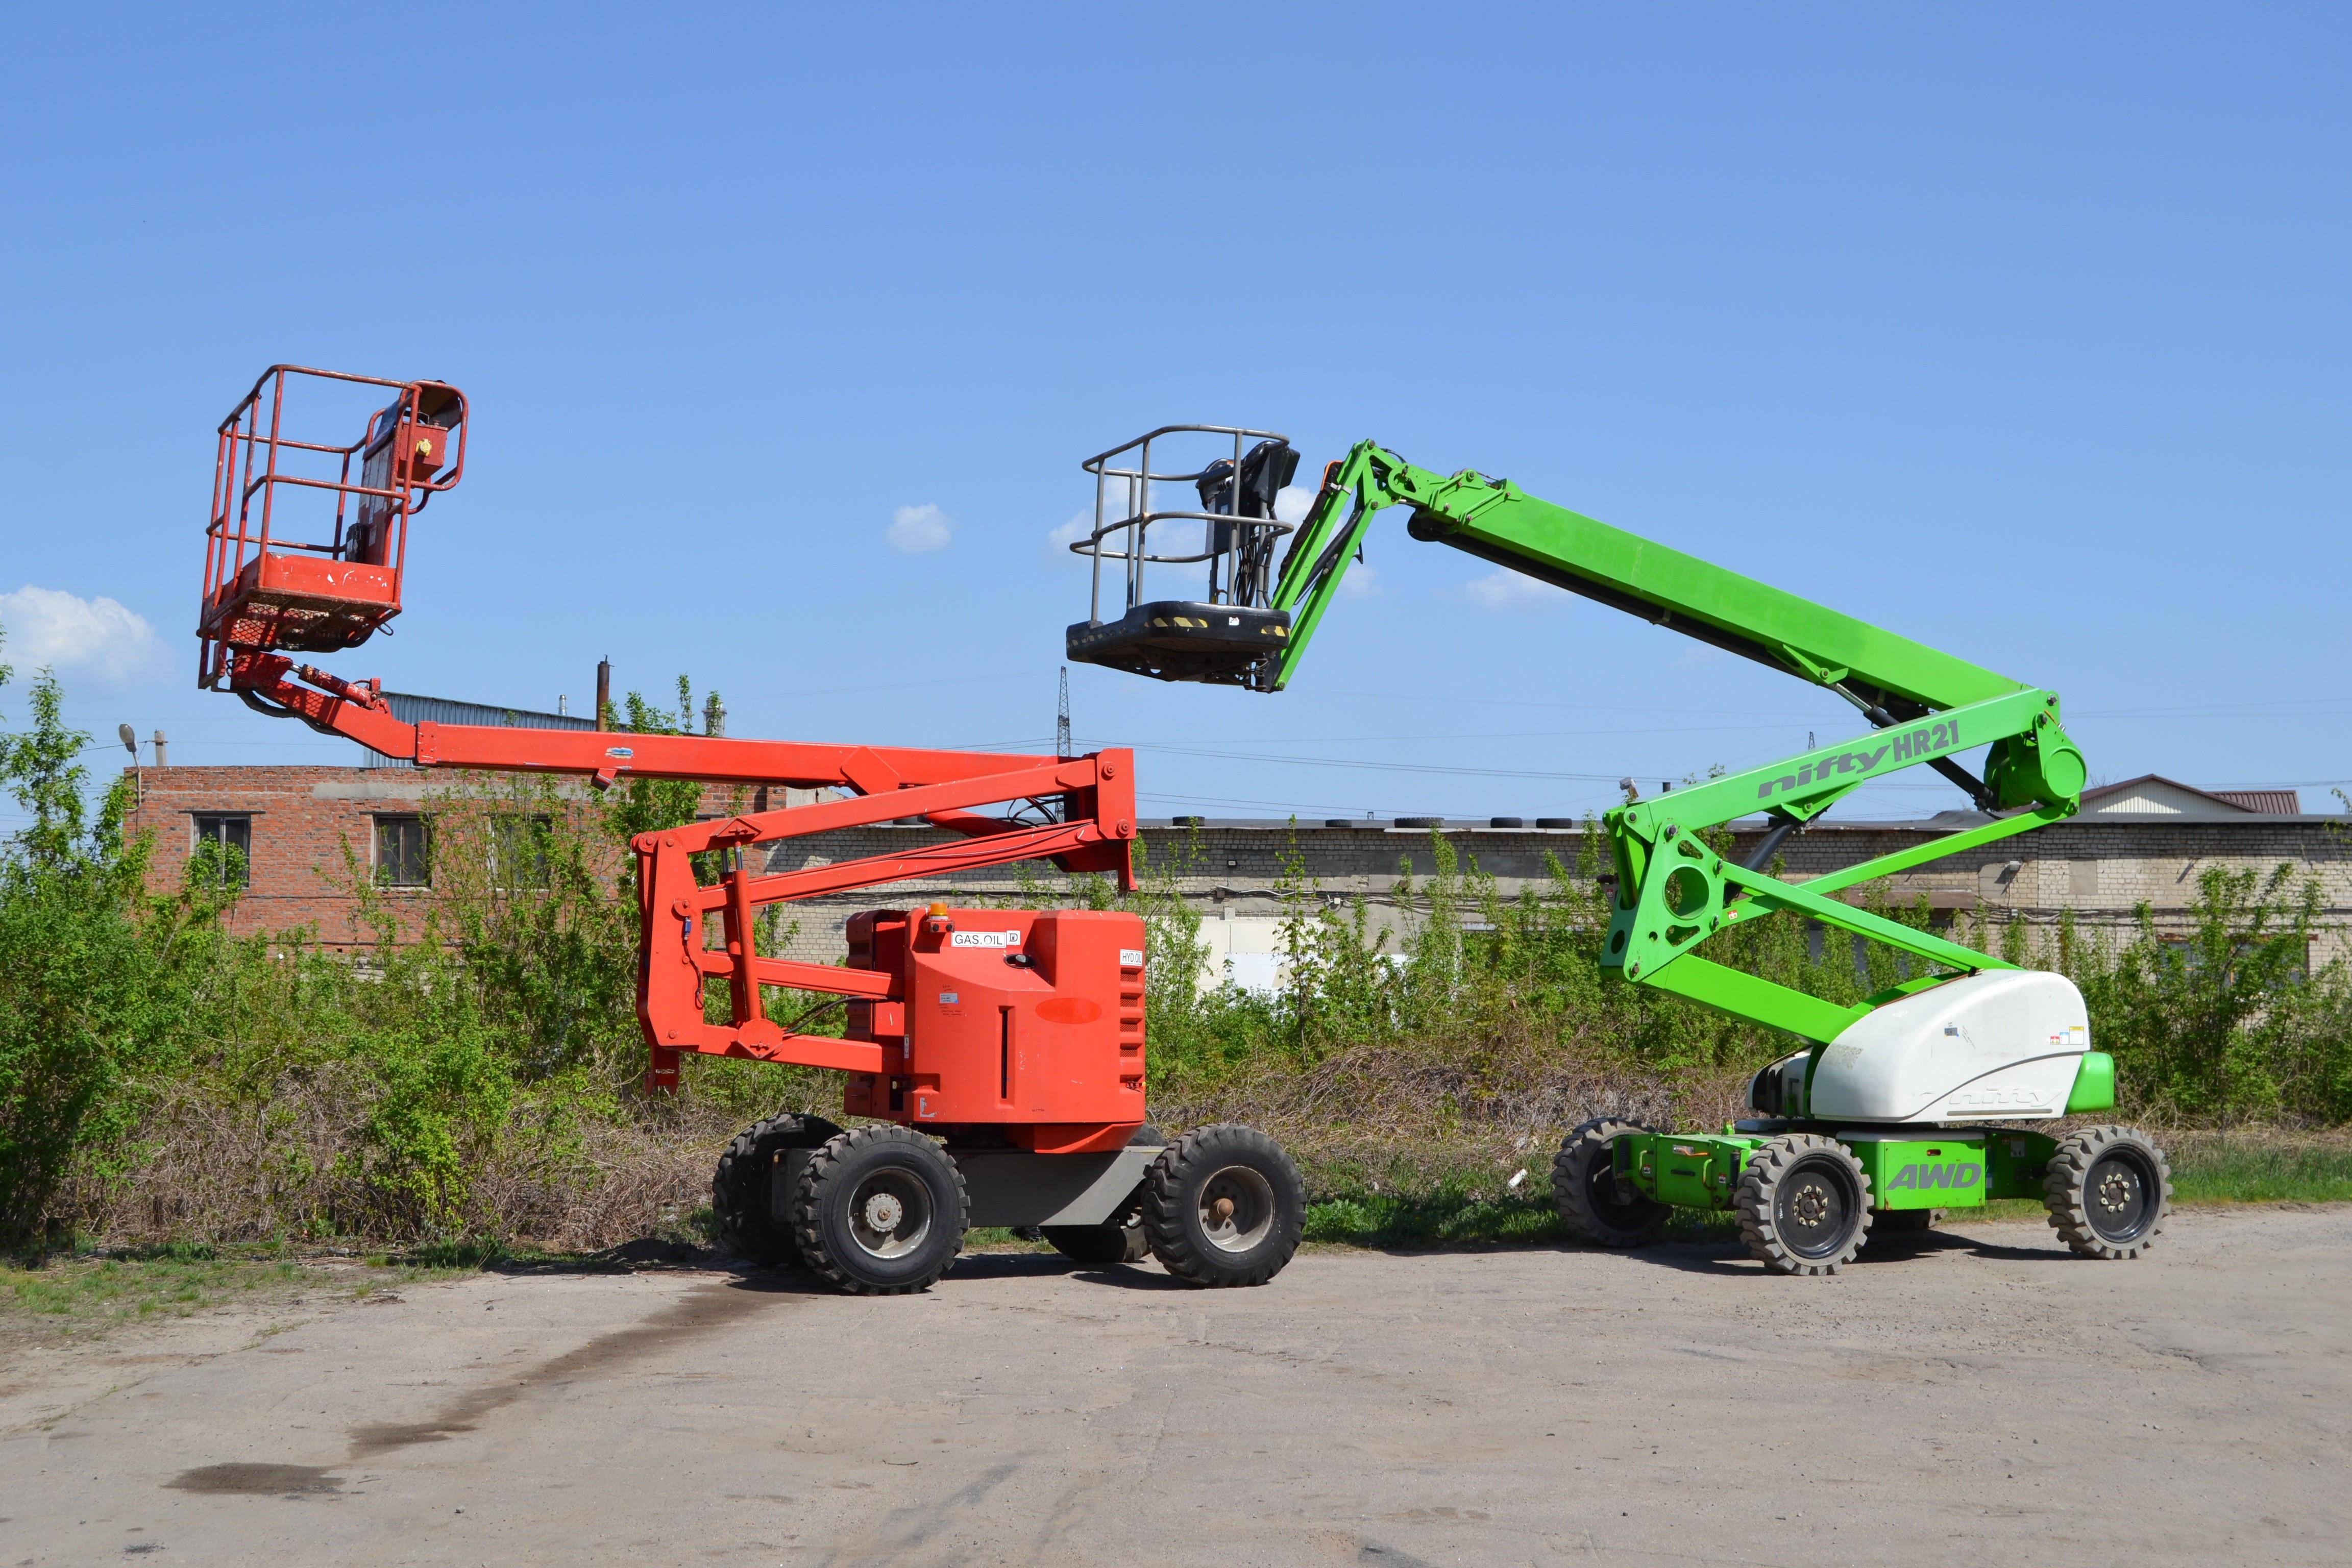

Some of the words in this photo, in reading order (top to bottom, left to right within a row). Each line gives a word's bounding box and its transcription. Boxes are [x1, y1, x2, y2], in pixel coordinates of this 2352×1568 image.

[1757, 745, 1891, 799] nifty
[1892, 719, 1959, 763] HR21
[1885, 1163, 1982, 1190] AWD
